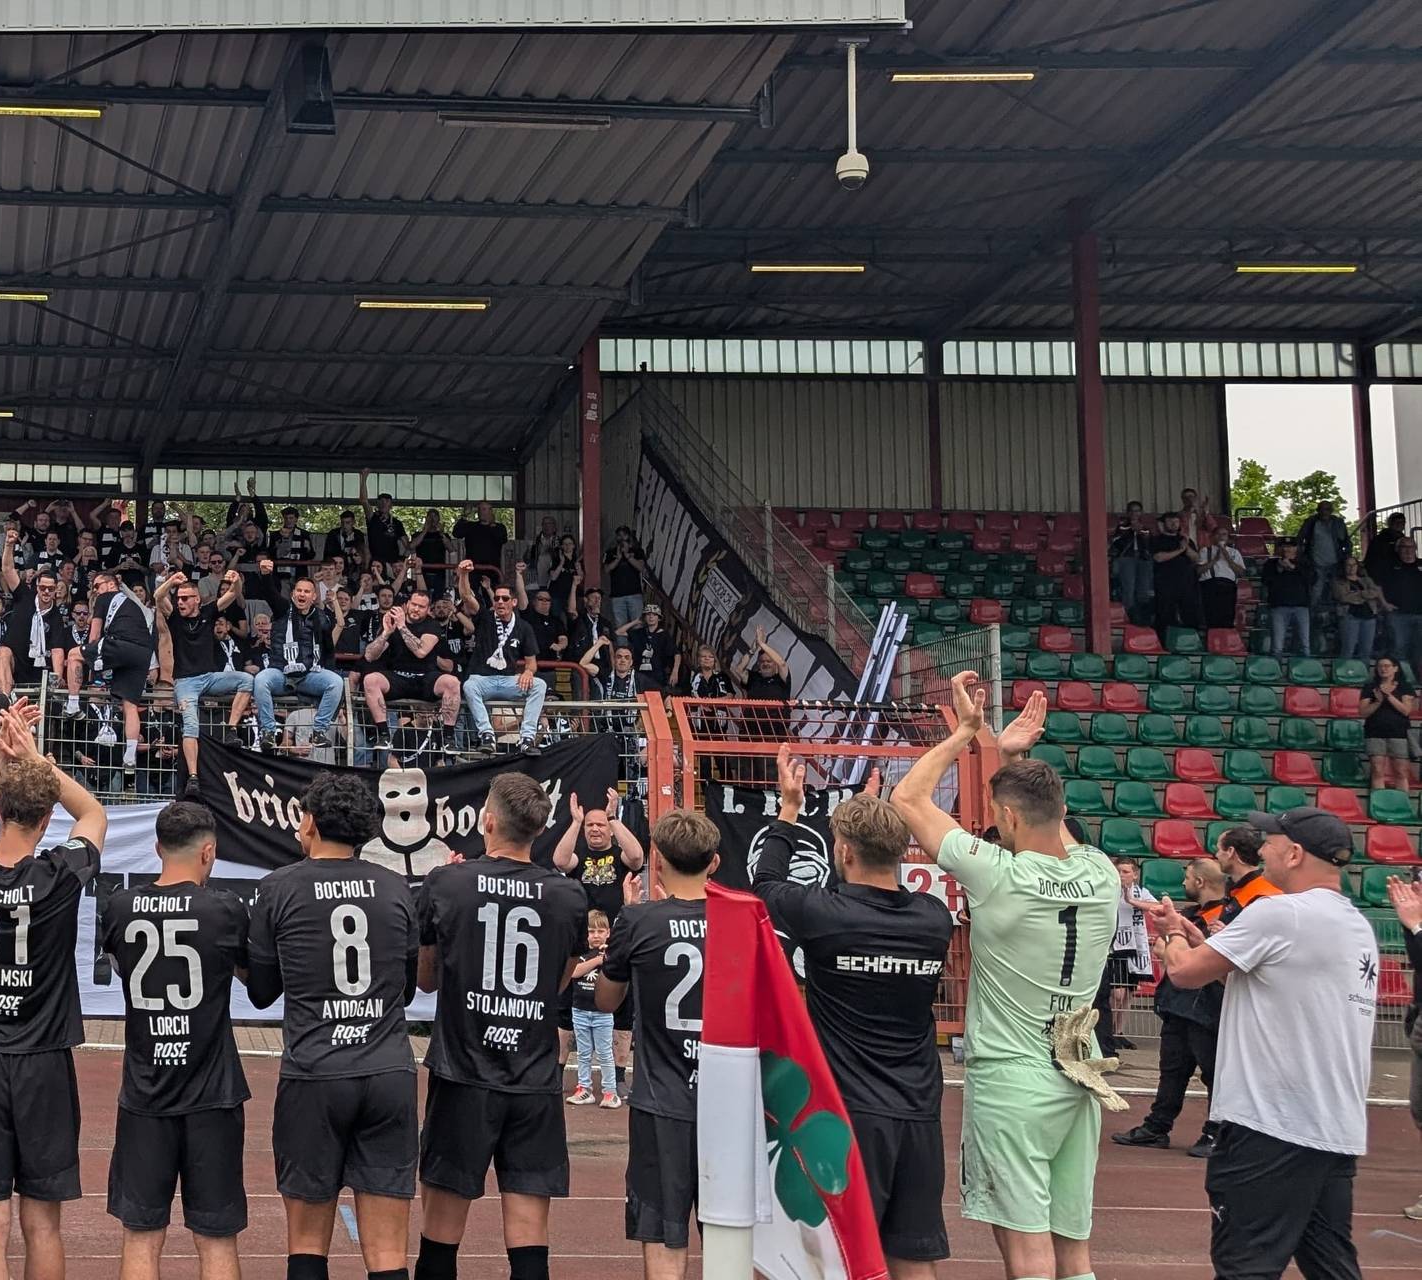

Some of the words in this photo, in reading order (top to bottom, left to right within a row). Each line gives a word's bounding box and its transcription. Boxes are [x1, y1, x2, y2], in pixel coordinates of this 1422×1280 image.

[314, 879, 376, 900] BOCHOLT
[478, 874, 544, 900] BOCHOLT
[1037, 877, 1096, 899] BOCHOLT
[132, 896, 192, 913] BOCHOLT
[668, 919, 708, 939] BOCH
[330, 903, 372, 997] 8
[478, 902, 542, 996] 16
[1058, 905, 1079, 987] 1
[125, 919, 204, 1011] 25
[664, 941, 704, 1032] 2
[322, 999, 384, 1020] AYDOGAN
[466, 991, 545, 1021] STOJANOVIC
[1049, 994, 1075, 1012] FOX
[149, 1015, 190, 1036] LORCH
[331, 1024, 372, 1040] ROSE
[483, 1025, 522, 1046] ROSE
[154, 1042, 190, 1058] ROSE
